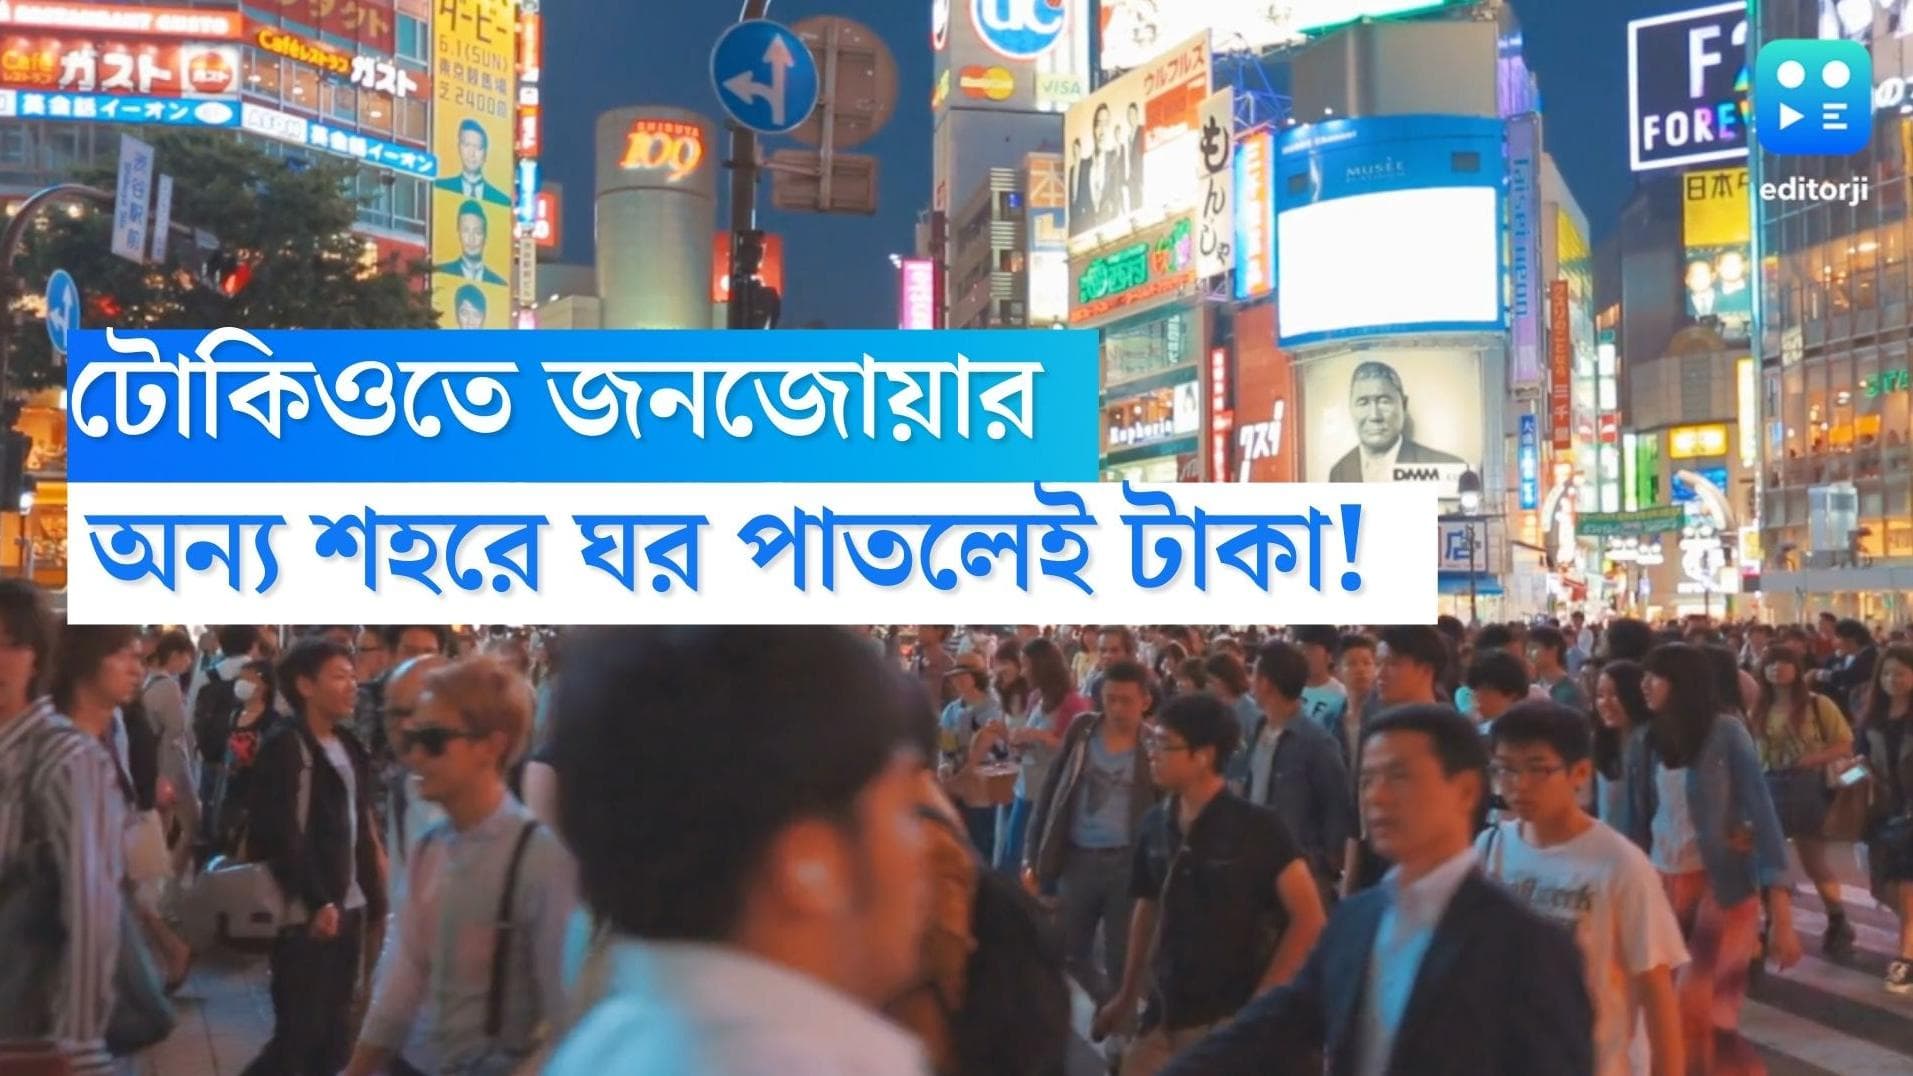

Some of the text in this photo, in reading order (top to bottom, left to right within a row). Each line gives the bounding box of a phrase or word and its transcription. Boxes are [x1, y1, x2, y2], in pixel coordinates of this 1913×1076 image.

[58, 44, 173, 94] ガスト
[350, 54, 418, 99] ガスト
[1041, 79, 1082, 96] VISA
[636, 120, 700, 137] SHIBUYA
[619, 131, 702, 183] 109
[1200, 115, 1231, 266] もんじゃ
[1392, 467, 1440, 482] DMM
